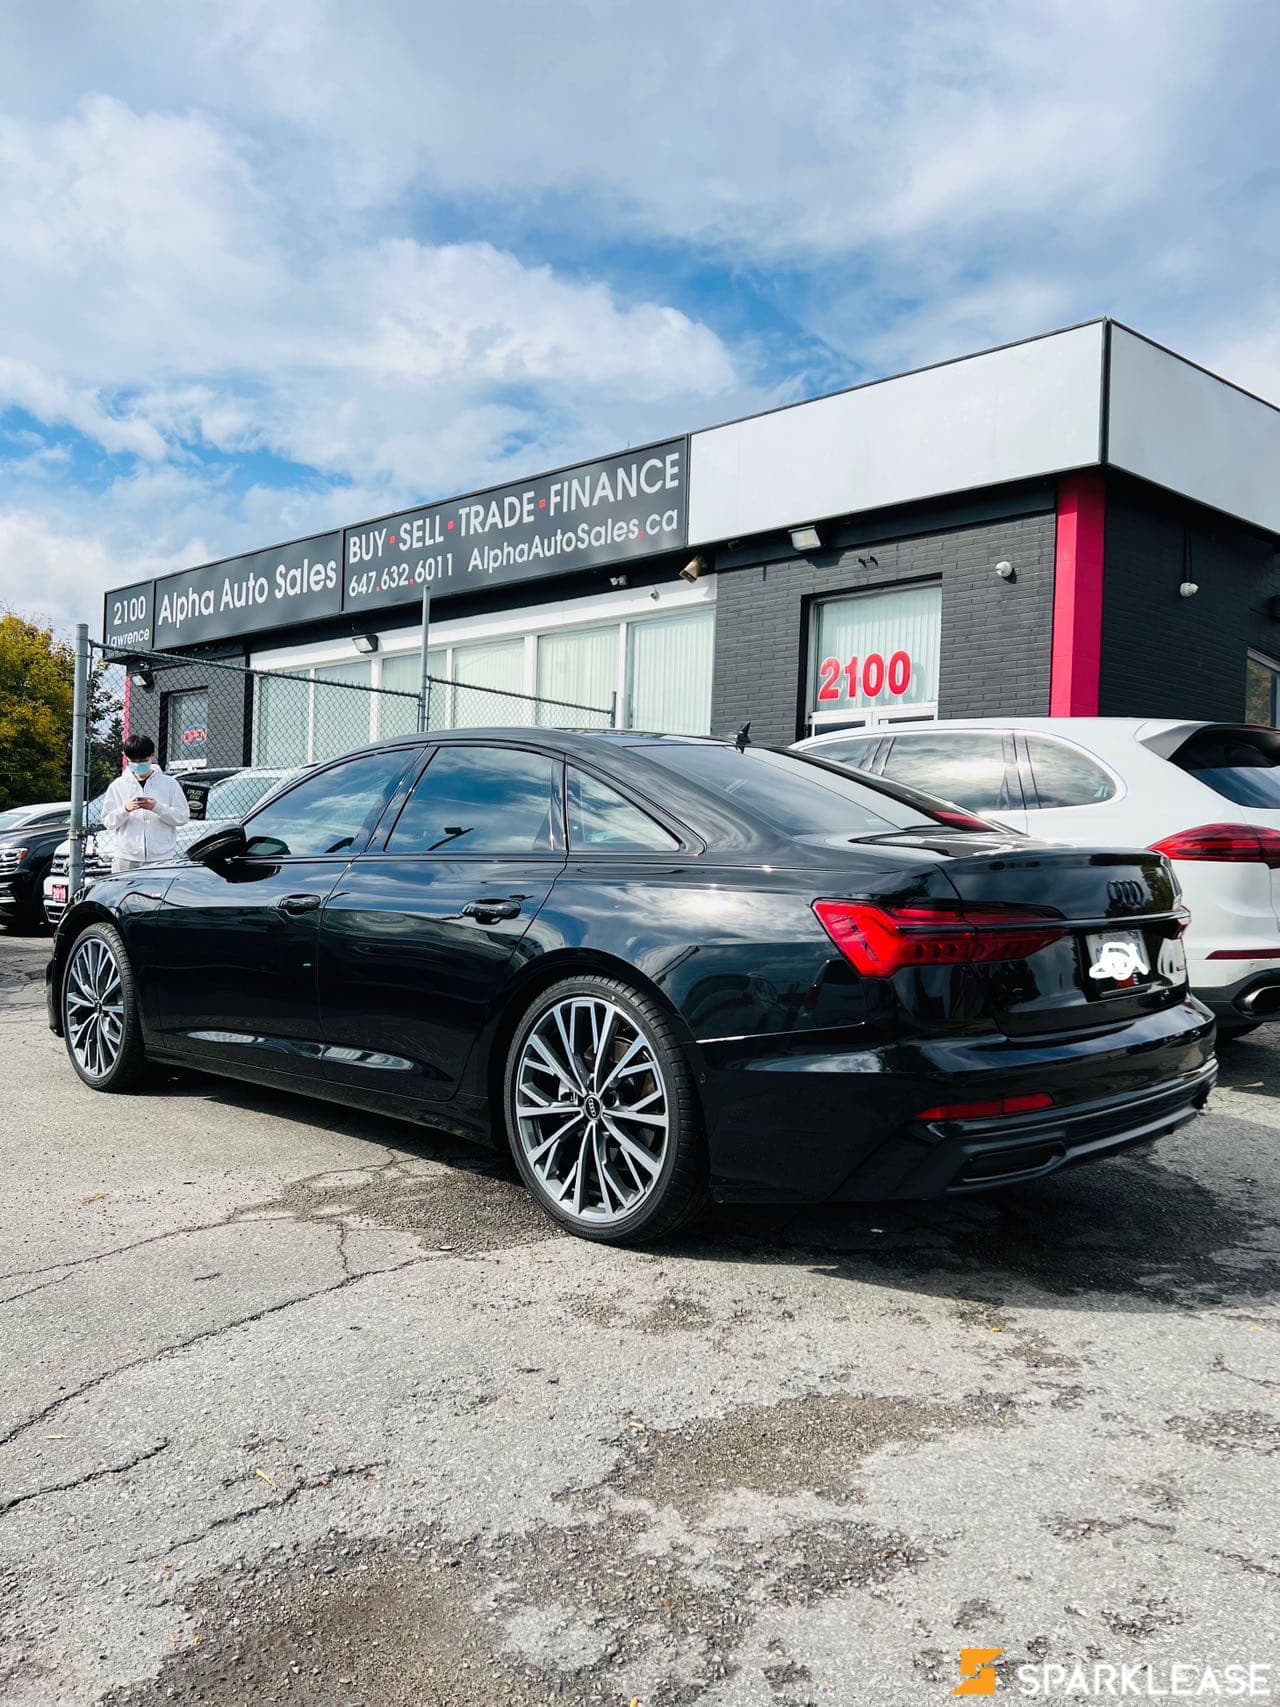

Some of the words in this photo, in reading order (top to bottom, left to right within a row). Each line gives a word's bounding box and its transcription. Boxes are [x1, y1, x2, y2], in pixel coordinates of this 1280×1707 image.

[349, 528, 387, 564] BUY
[399, 515, 444, 551] SELL
[458, 491, 536, 537] TRADE
[549, 452, 680, 518] FINANCE
[467, 508, 679, 574] AlphaAutoSales.ca
[157, 586, 215, 629] Alpha
[219, 572, 269, 612] Auto
[274, 558, 338, 600] Sales
[348, 552, 453, 597] 647.632.6011
[113, 595, 146, 626] 2100
[818, 650, 912, 702] 2100
